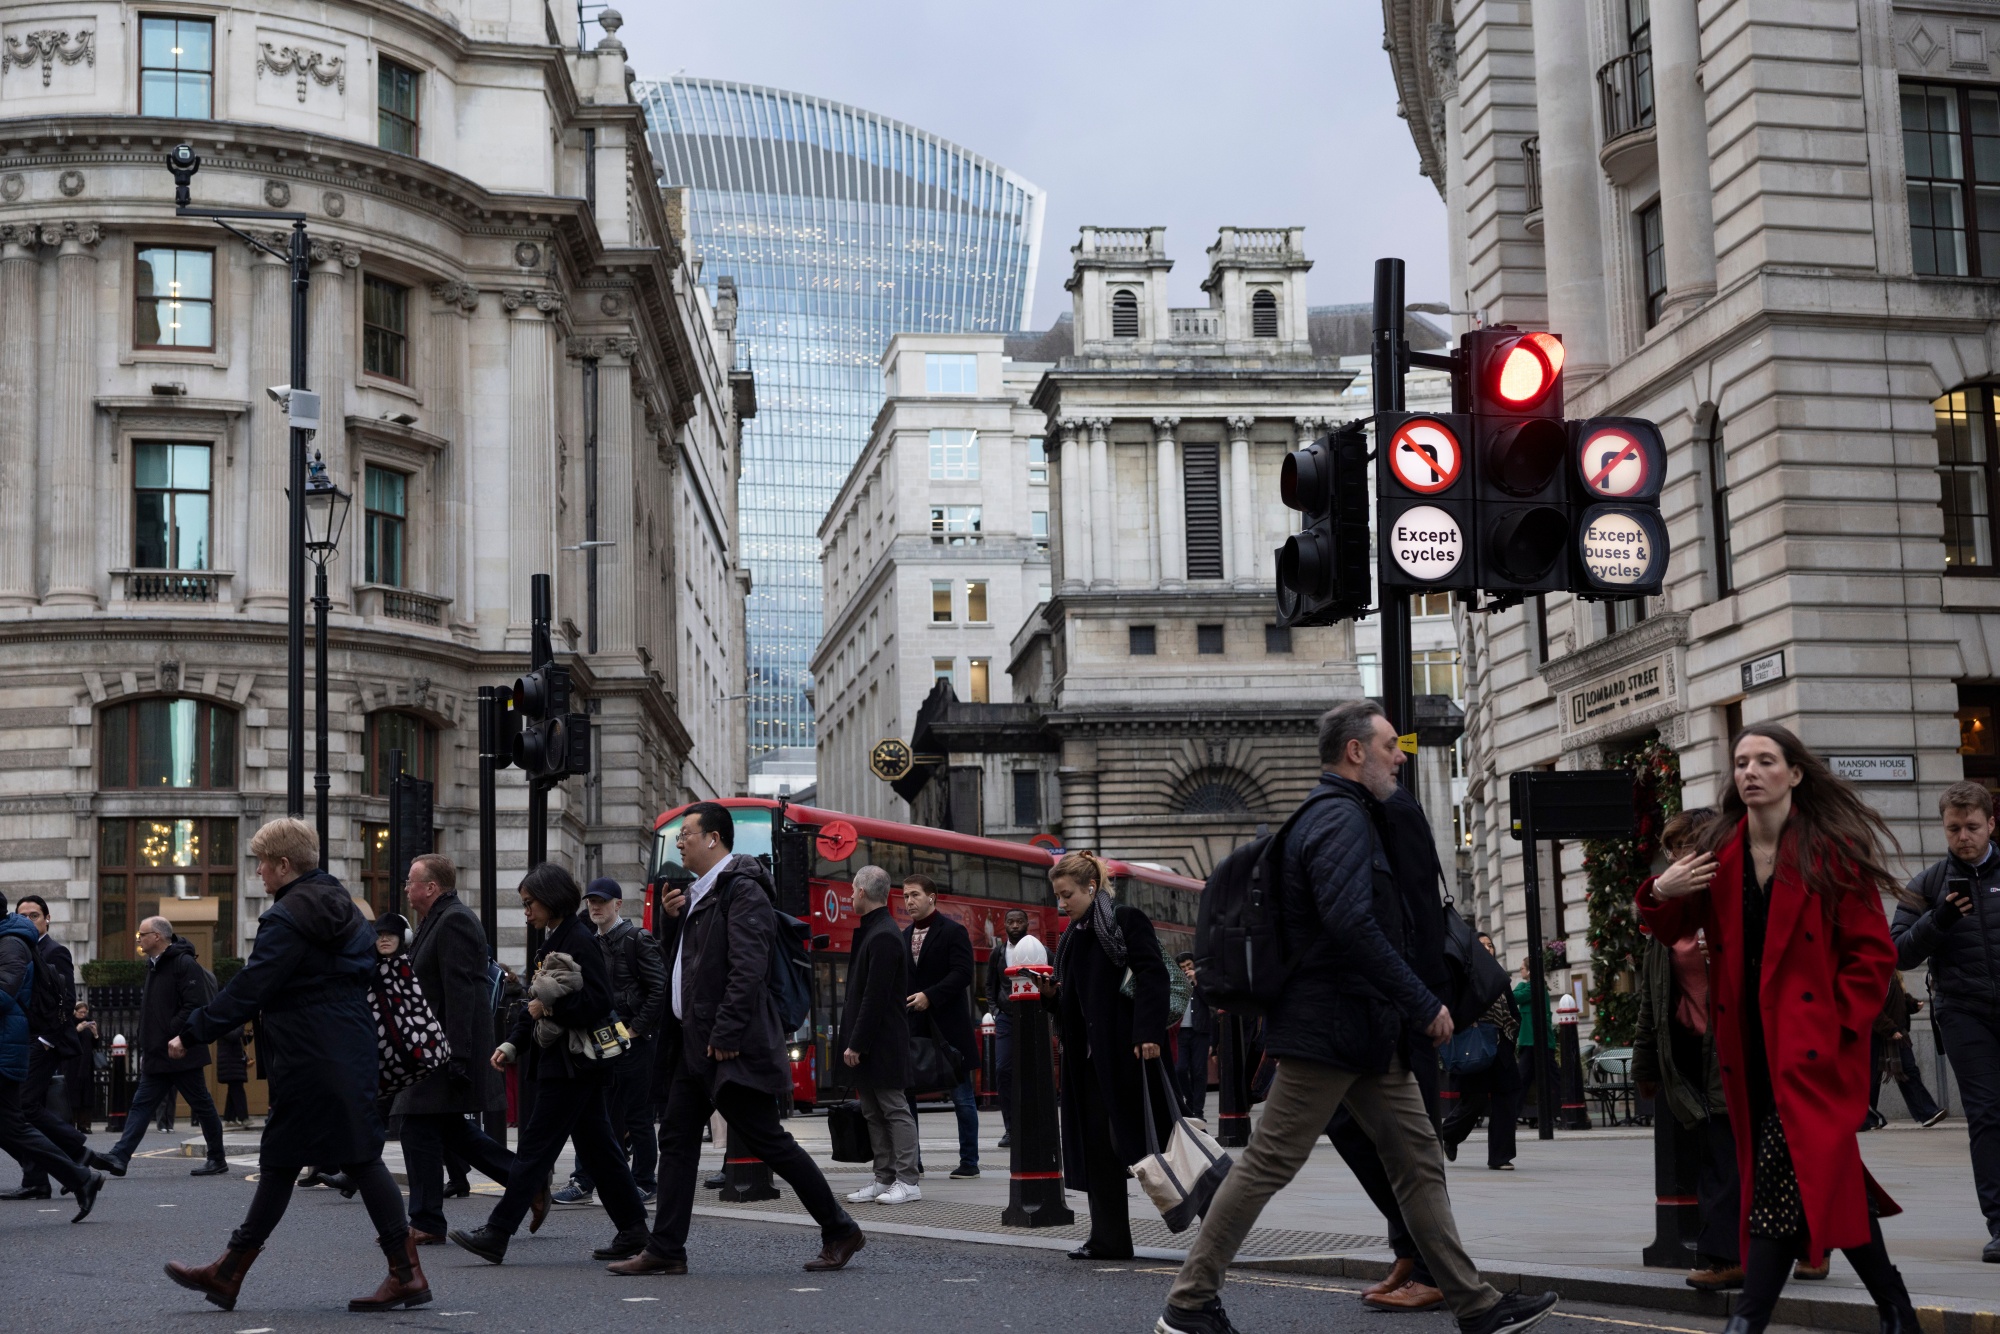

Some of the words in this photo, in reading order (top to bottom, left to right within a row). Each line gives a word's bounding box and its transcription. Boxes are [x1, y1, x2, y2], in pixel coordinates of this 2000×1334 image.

[1398, 527, 1457, 546] Except
[1588, 527, 1643, 546] Except
[1401, 547, 1455, 564] cycles
[1585, 544, 1630, 561] buses
[1636, 547, 1647, 560] &
[1590, 563, 1641, 579] cycles
[1755, 660, 1773, 672] LOMBARD
[1755, 670, 1769, 681] STREET
[1586, 680, 1625, 706] LOMBARD
[1628, 666, 1658, 691] STREET
[1838, 760, 1877, 768] MANSION
[1880, 760, 1907, 768] HOUSE
[1839, 769, 1863, 777] PLACE
[1892, 769, 1907, 777] EC4
[600, 1030, 610, 1041] B
